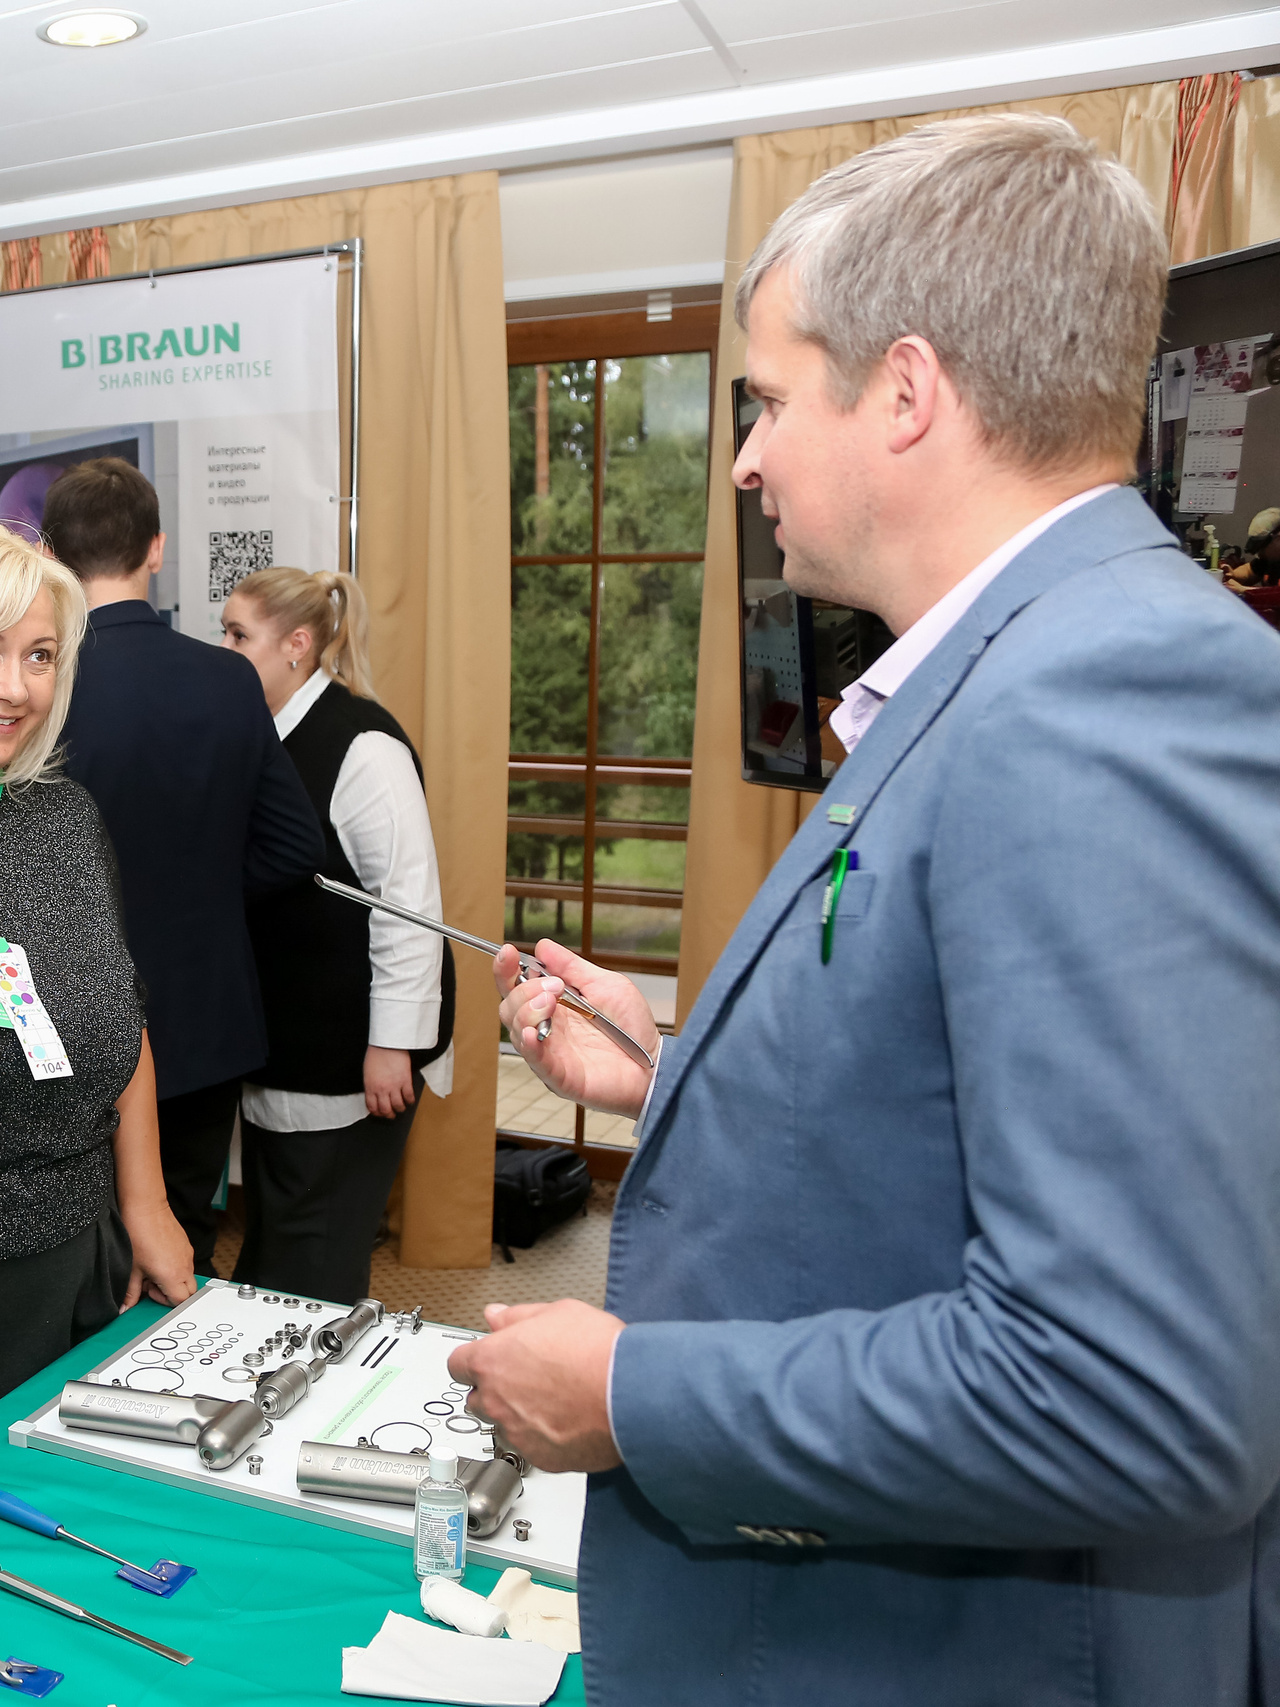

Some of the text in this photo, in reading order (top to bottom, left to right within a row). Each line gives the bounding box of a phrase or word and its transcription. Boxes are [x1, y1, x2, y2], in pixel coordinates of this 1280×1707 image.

[61, 322, 240, 369] B BRAUN
[99, 360, 272, 391] SHARING EXPERTISE
[207, 446, 266, 457] Интересные
[208, 462, 261, 473] материалы
[217, 479, 246, 489] видео
[217, 495, 270, 506] продукции
[41, 1062, 63, 1074] 104
[97, 1396, 170, 1418] Acculan
[350, 1458, 430, 1480] Acculan
